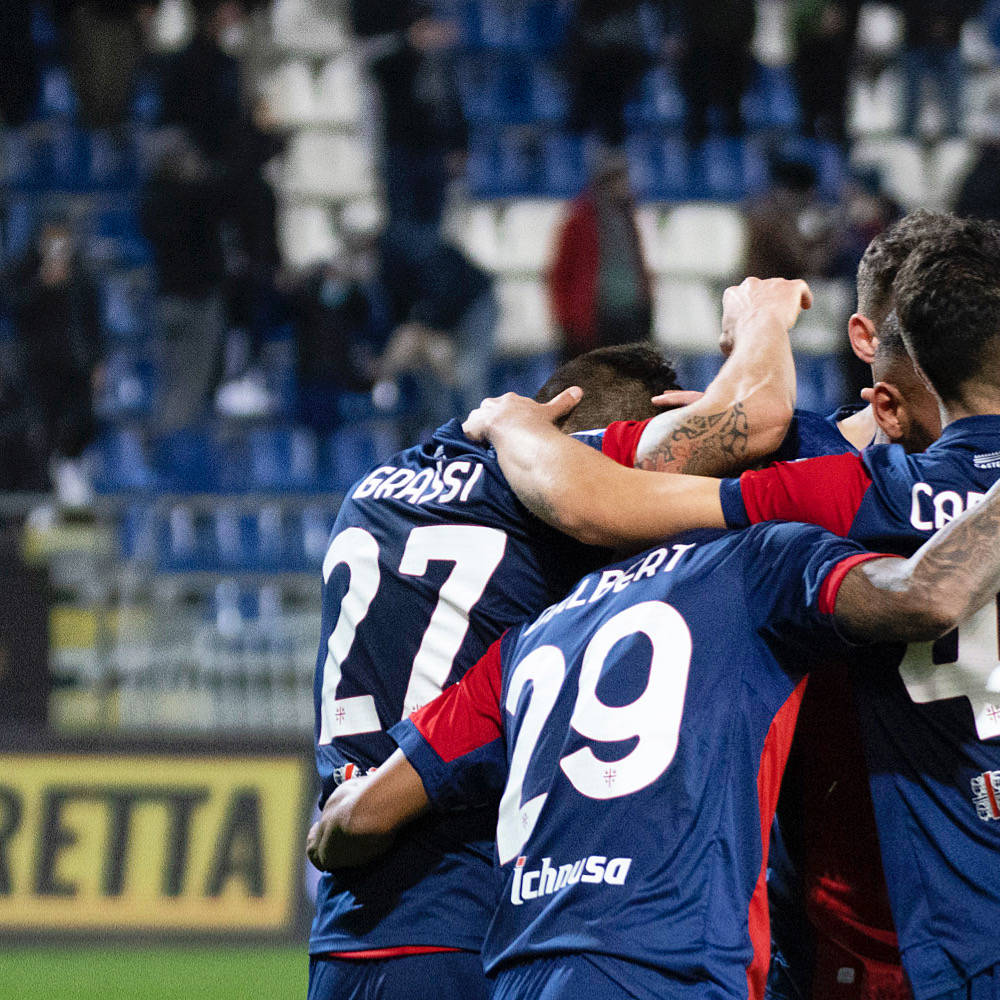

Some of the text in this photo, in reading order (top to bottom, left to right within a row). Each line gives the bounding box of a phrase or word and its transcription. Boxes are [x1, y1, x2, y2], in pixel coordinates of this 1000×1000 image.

[352, 461, 484, 504] GRASSI
[319, 525, 507, 745] 27
[497, 600, 692, 865] 29
